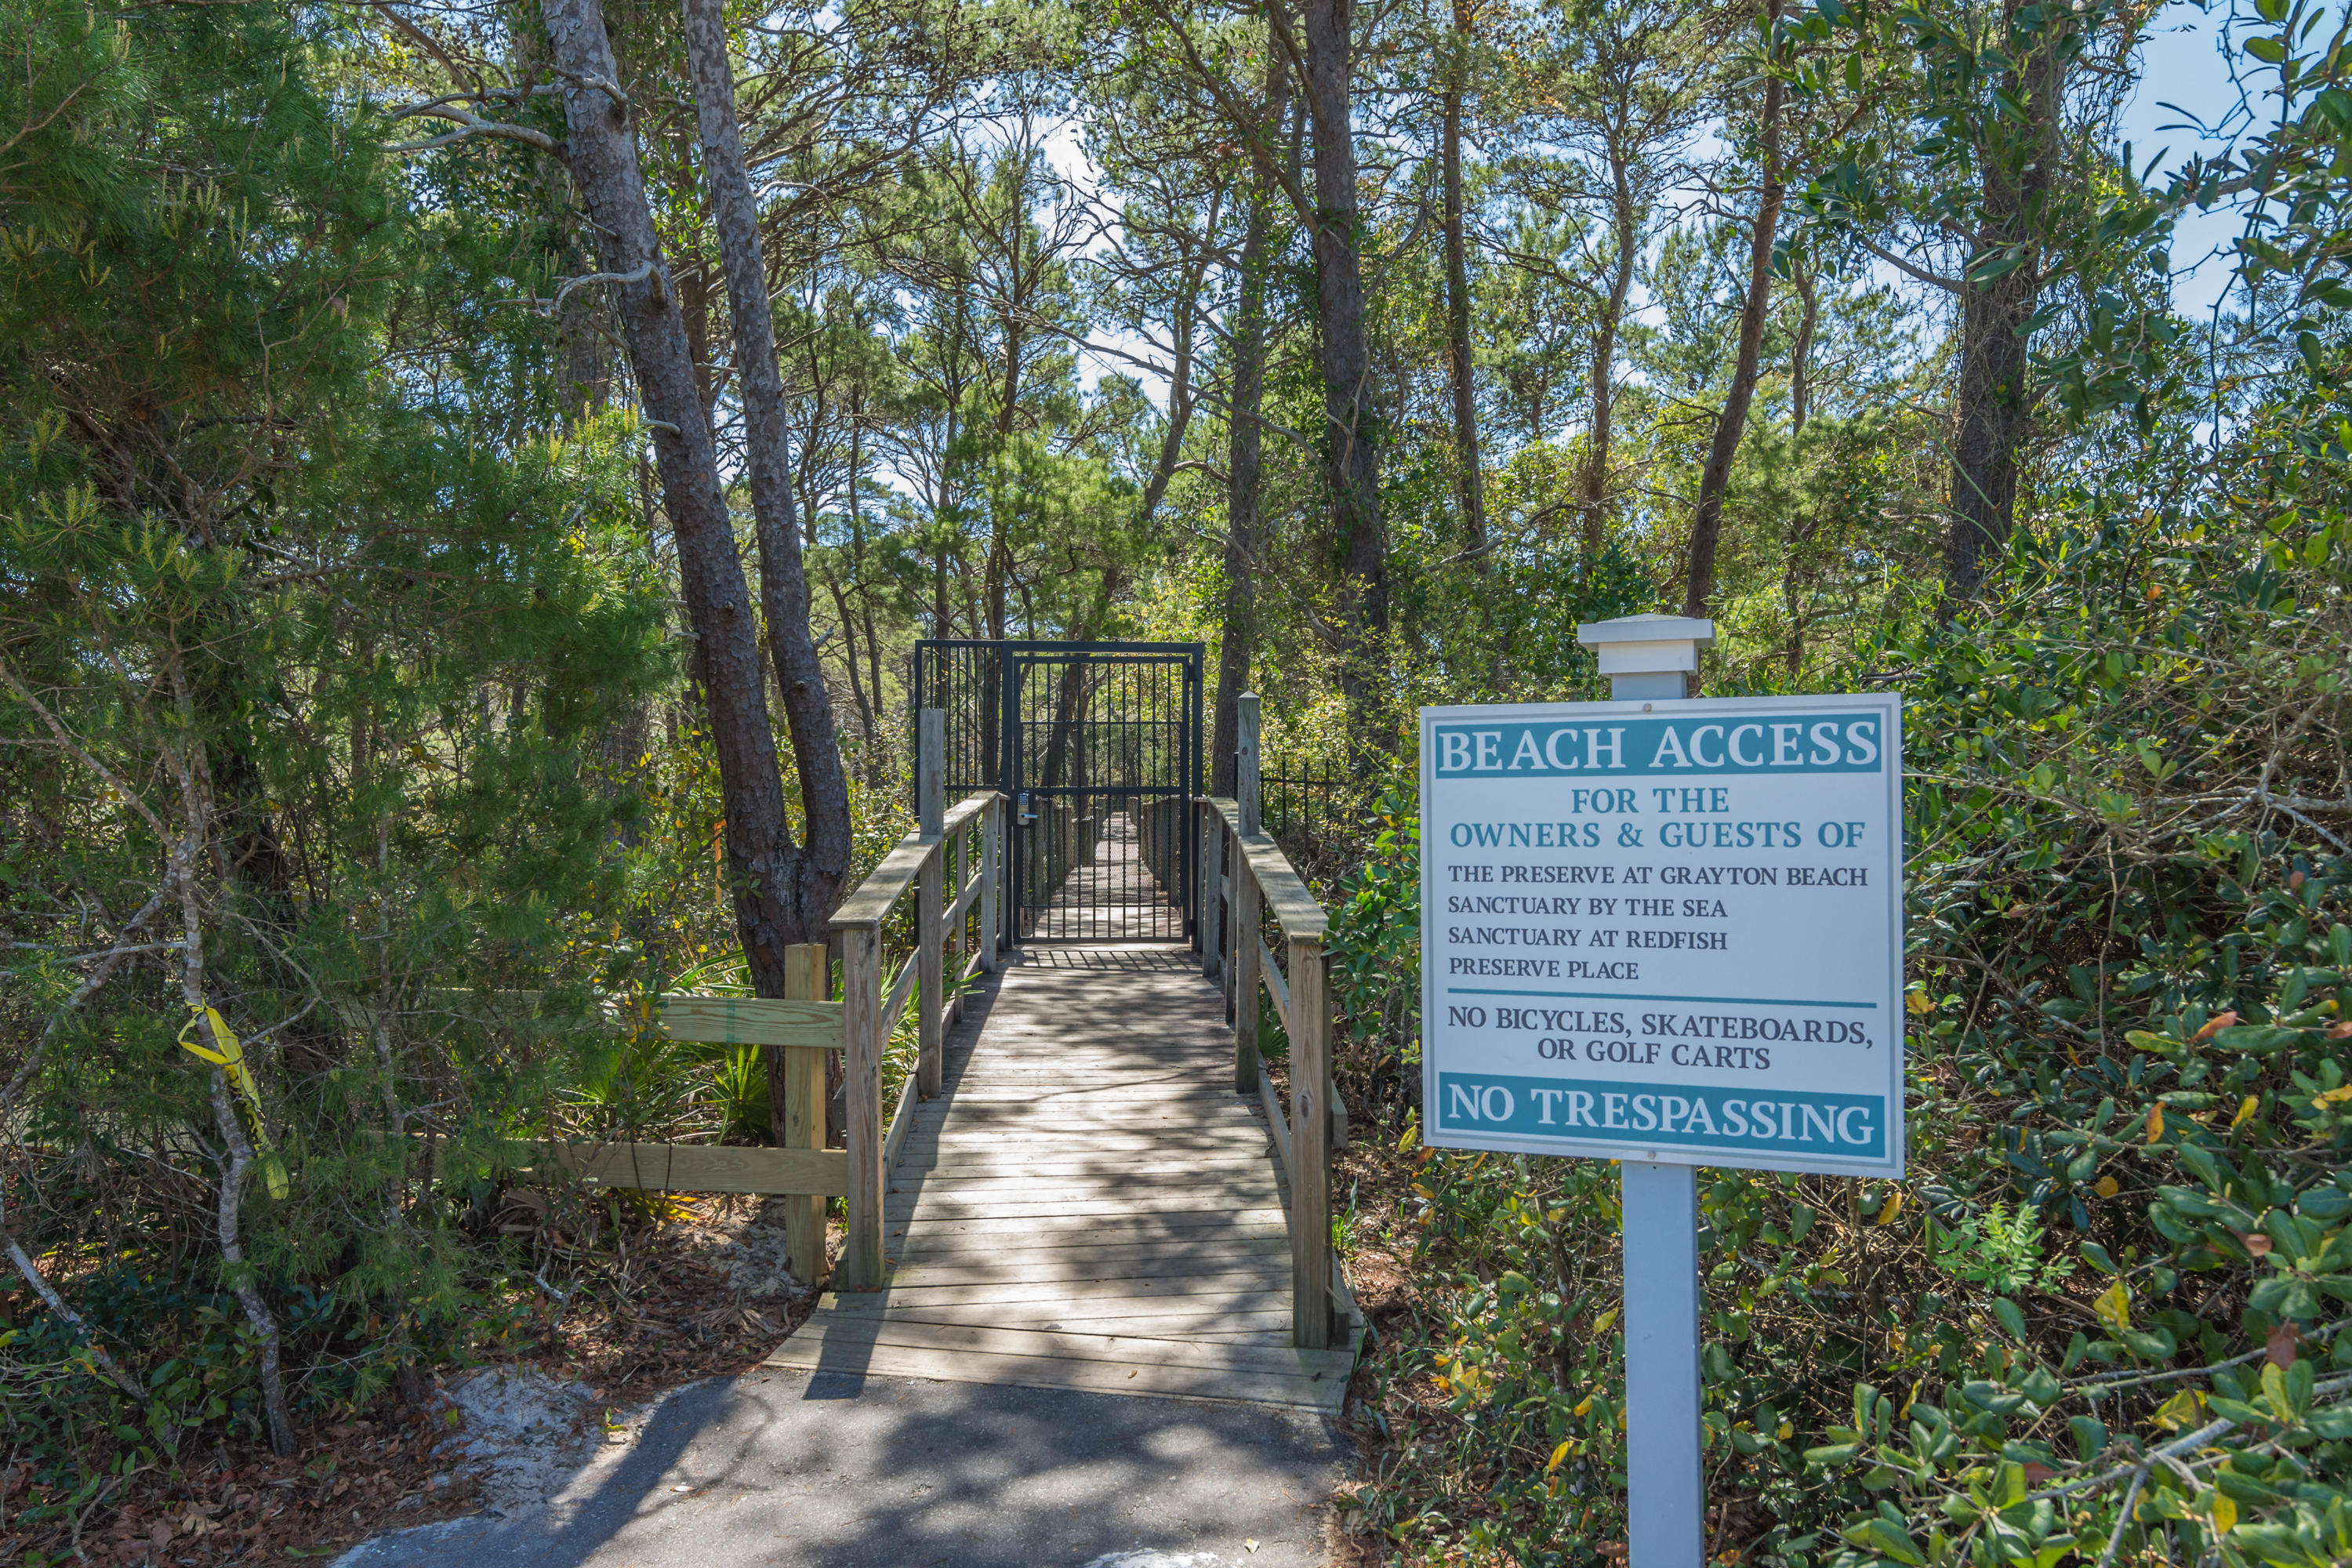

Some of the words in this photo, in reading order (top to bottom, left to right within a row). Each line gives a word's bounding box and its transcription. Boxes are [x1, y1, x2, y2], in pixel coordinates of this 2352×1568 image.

[1439, 728, 1626, 771] BEACH
[1649, 720, 1878, 768] ACCESS
[1572, 789, 1639, 813] FOR
[1653, 788, 1729, 812] THE
[1450, 822, 1599, 847] OWNERS
[1617, 822, 1643, 847] &
[1660, 822, 1801, 848] GUESTS
[1818, 822, 1864, 848] OF
[1448, 866, 1493, 882] THE
[1501, 866, 1614, 883] PRESERVE
[1622, 866, 1653, 884] AT
[1661, 867, 1778, 885] GRAYTON
[1787, 868, 1867, 886] BEACH
[1449, 896, 1581, 914] SANCTUARY
[1588, 898, 1617, 915] BY
[1625, 899, 1674, 916] THE
[1683, 899, 1728, 917] SEA
[1449, 927, 1581, 946] SANCTUARY
[1588, 930, 1618, 947] AT
[1626, 931, 1727, 949] REDFISH
[1449, 958, 1559, 977] PRESERVE
[1568, 961, 1639, 979] PLACE
[1449, 1006, 1486, 1027] NO
[1496, 1008, 1631, 1038] BICYCLES,
[1642, 1014, 1872, 1051] SKATEBOARDS,
[1538, 1039, 1577, 1060] OR
[1586, 1040, 1661, 1064] GOLF
[1671, 1044, 1770, 1069] CARTS
[1449, 1084, 1514, 1121] NO
[1530, 1088, 1875, 1145] TRESPASSING
